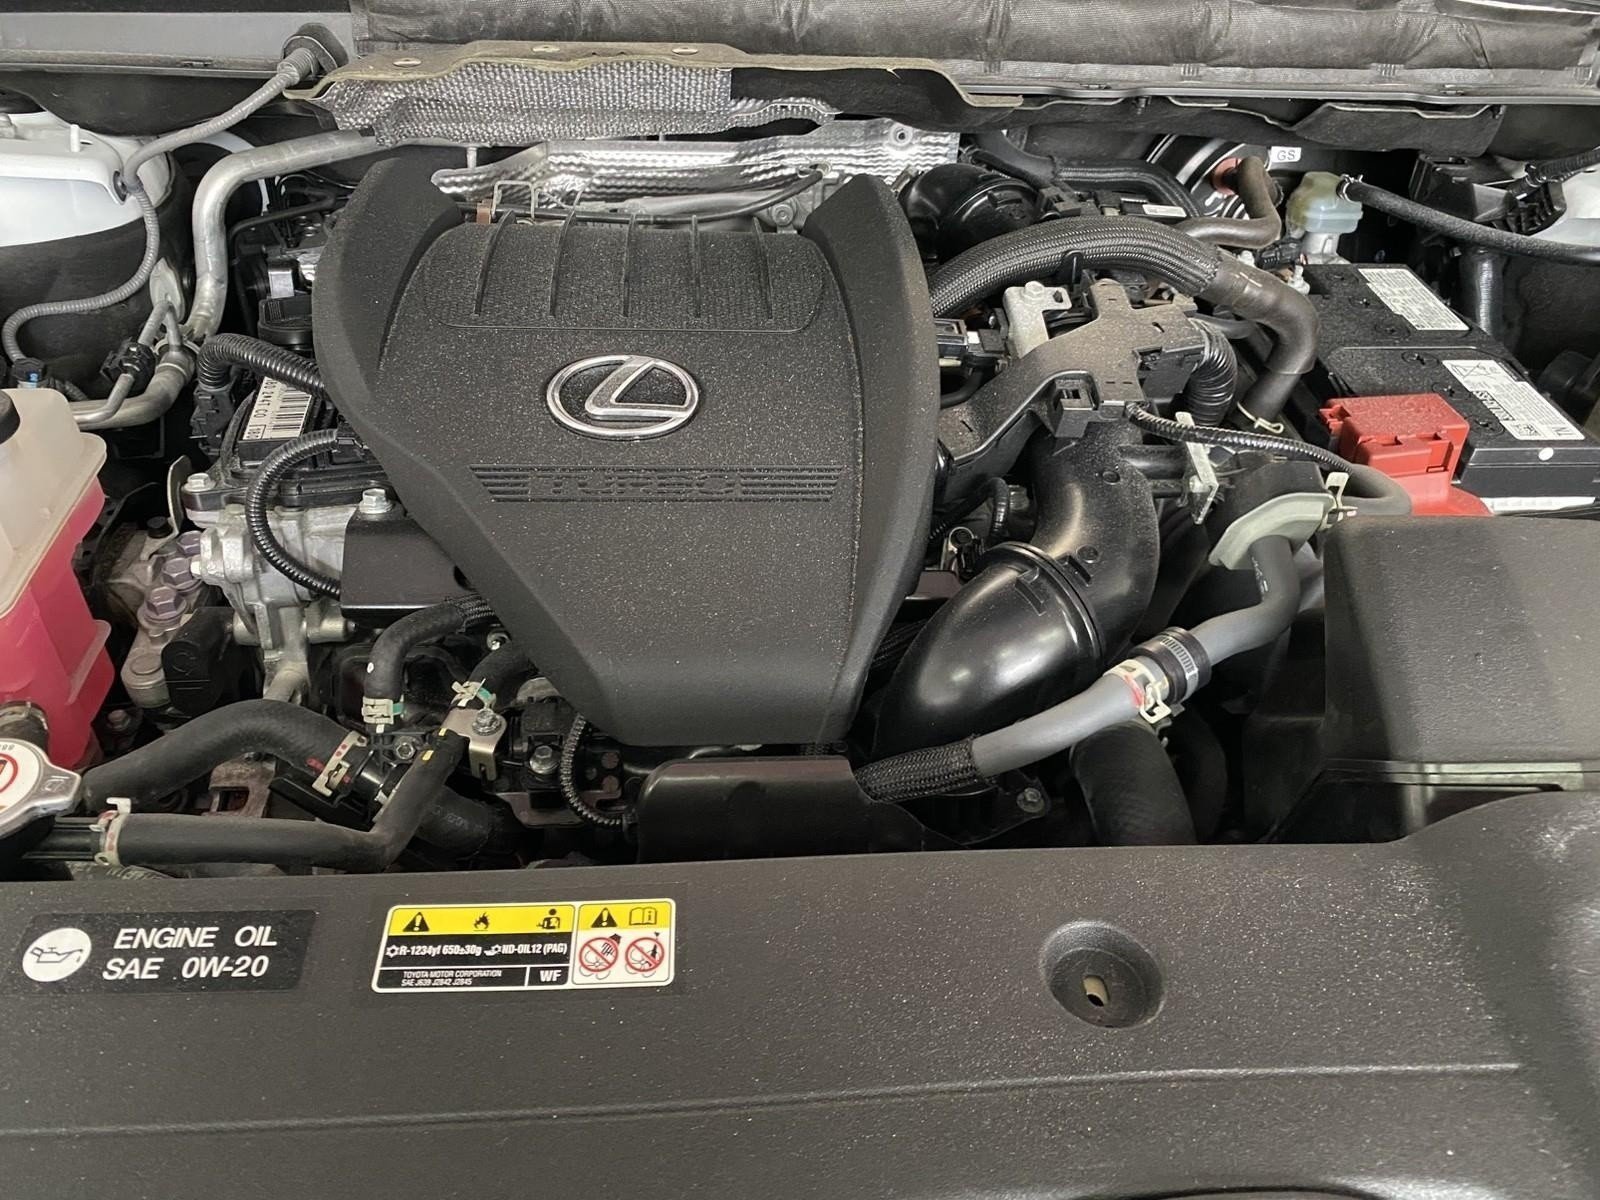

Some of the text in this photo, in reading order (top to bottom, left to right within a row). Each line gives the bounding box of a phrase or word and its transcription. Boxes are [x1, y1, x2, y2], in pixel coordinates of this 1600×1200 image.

[1277, 149, 1296, 161] GS
[113, 925, 278, 949] ENGINE OIL
[400, 945, 441, 957] R-1234yf
[543, 943, 567, 955] (PAG)
[102, 955, 270, 980] SAE 0W-20
[403, 969, 503, 979] TOYOTA MOTOR CORPORATION
[540, 969, 562, 982] WF
[401, 978, 415, 987] SAE
